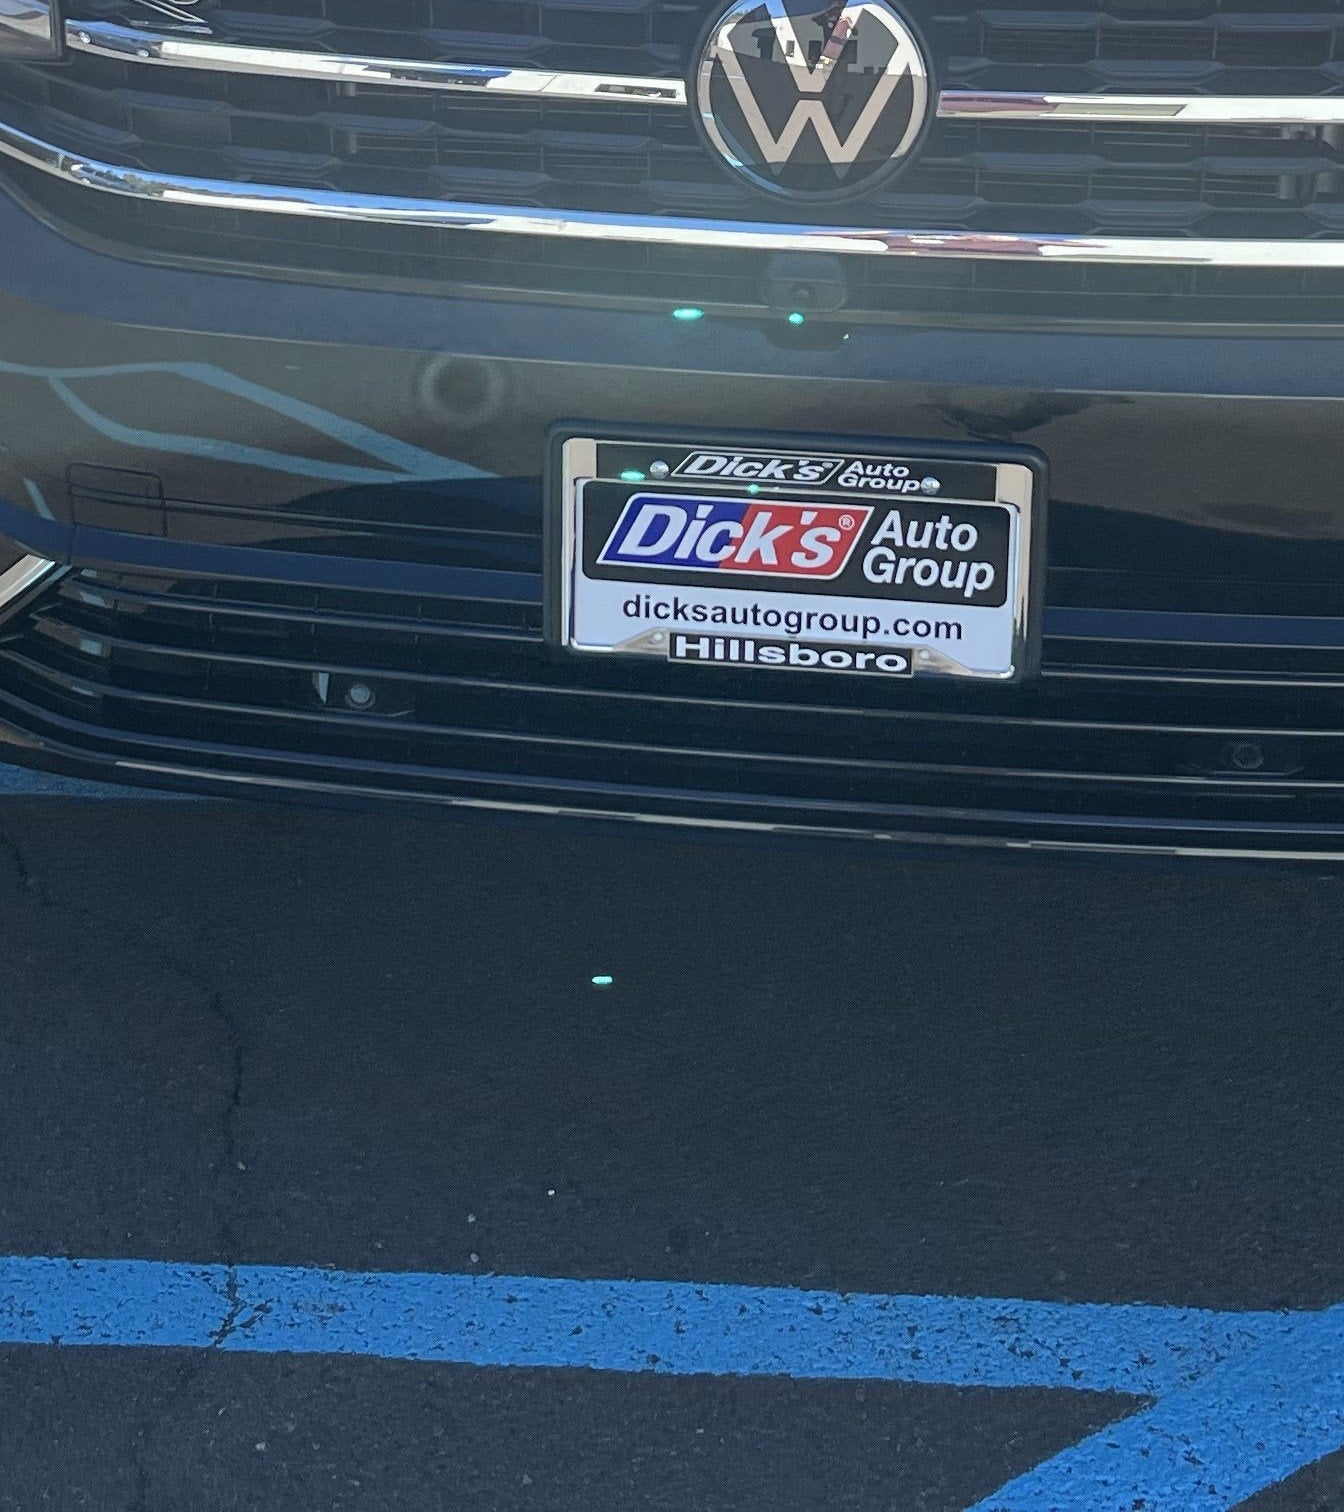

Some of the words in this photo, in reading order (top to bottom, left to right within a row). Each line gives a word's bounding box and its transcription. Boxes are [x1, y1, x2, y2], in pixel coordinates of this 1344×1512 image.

[837, 474, 920, 493] Group
[844, 461, 910, 478] Auto
[870, 510, 978, 552] Auto
[862, 546, 995, 597] Group
[622, 595, 963, 641] dicksautogroup.com
[675, 635, 907, 672] Hillsboro
